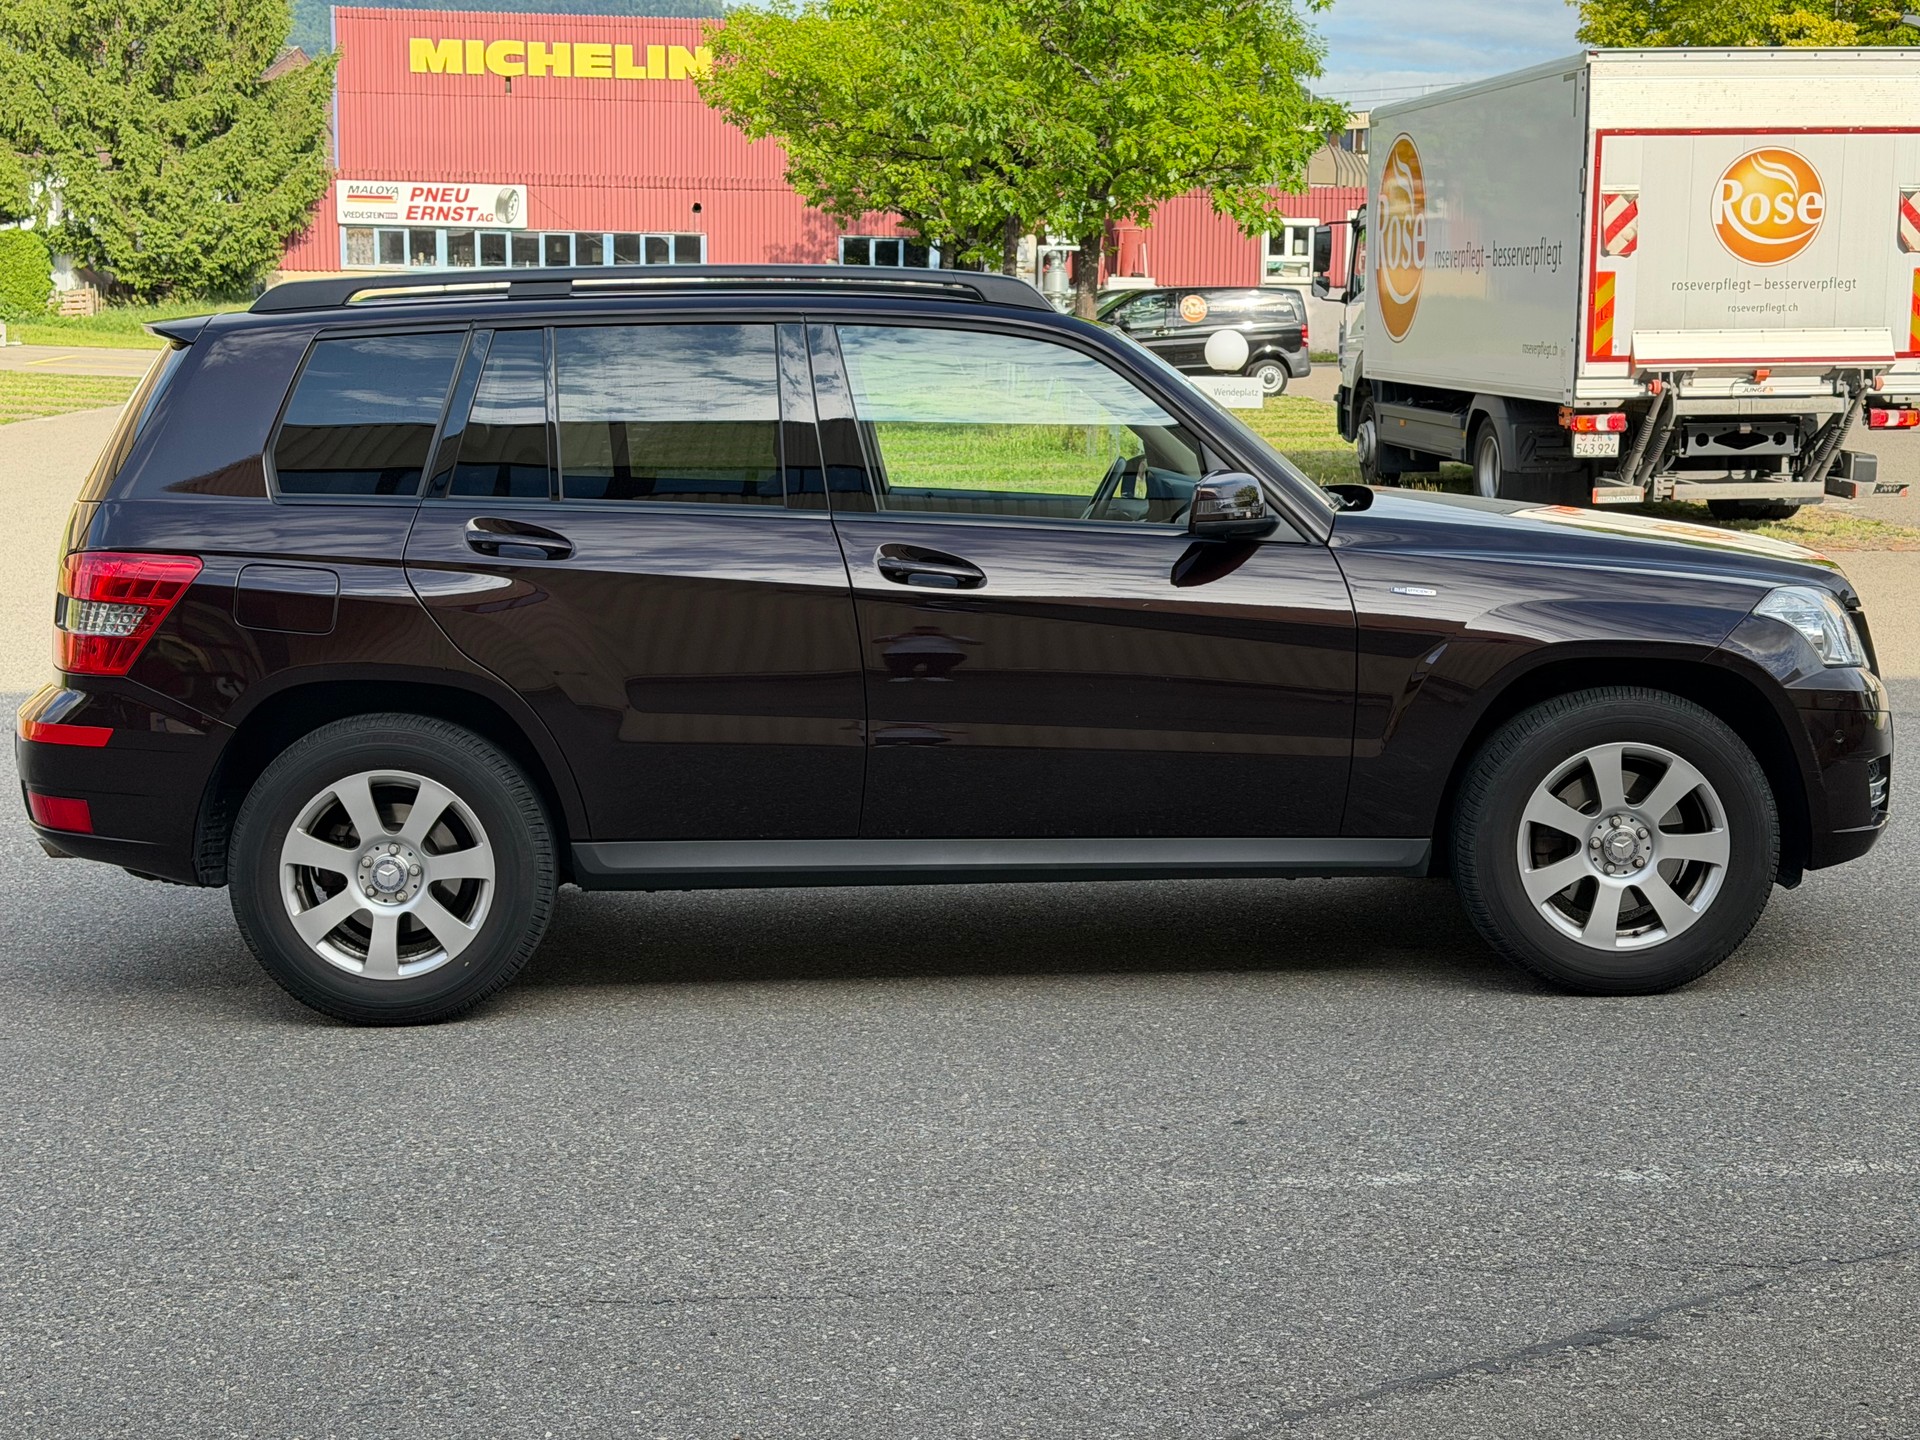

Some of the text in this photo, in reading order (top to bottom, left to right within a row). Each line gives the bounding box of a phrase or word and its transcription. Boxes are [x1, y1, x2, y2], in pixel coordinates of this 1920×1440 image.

[409, 37, 713, 80] MICHELIN
[347, 185, 399, 196] MALOYA
[409, 187, 470, 203] PNEU
[1711, 178, 1824, 226] Rose
[405, 206, 479, 222] ERNST
[477, 213, 494, 222] AG
[1376, 194, 1426, 271] Rose
[1434, 241, 1484, 274] roseverpflegt
[1492, 237, 1562, 273] besserverpflegt
[1671, 277, 1751, 293] roseverpflegt
[1764, 276, 1857, 293] besserverpflegt
[1727, 302, 1799, 315] roseverpflegt.ch
[1213, 387, 1259, 398] Wendeplatz
